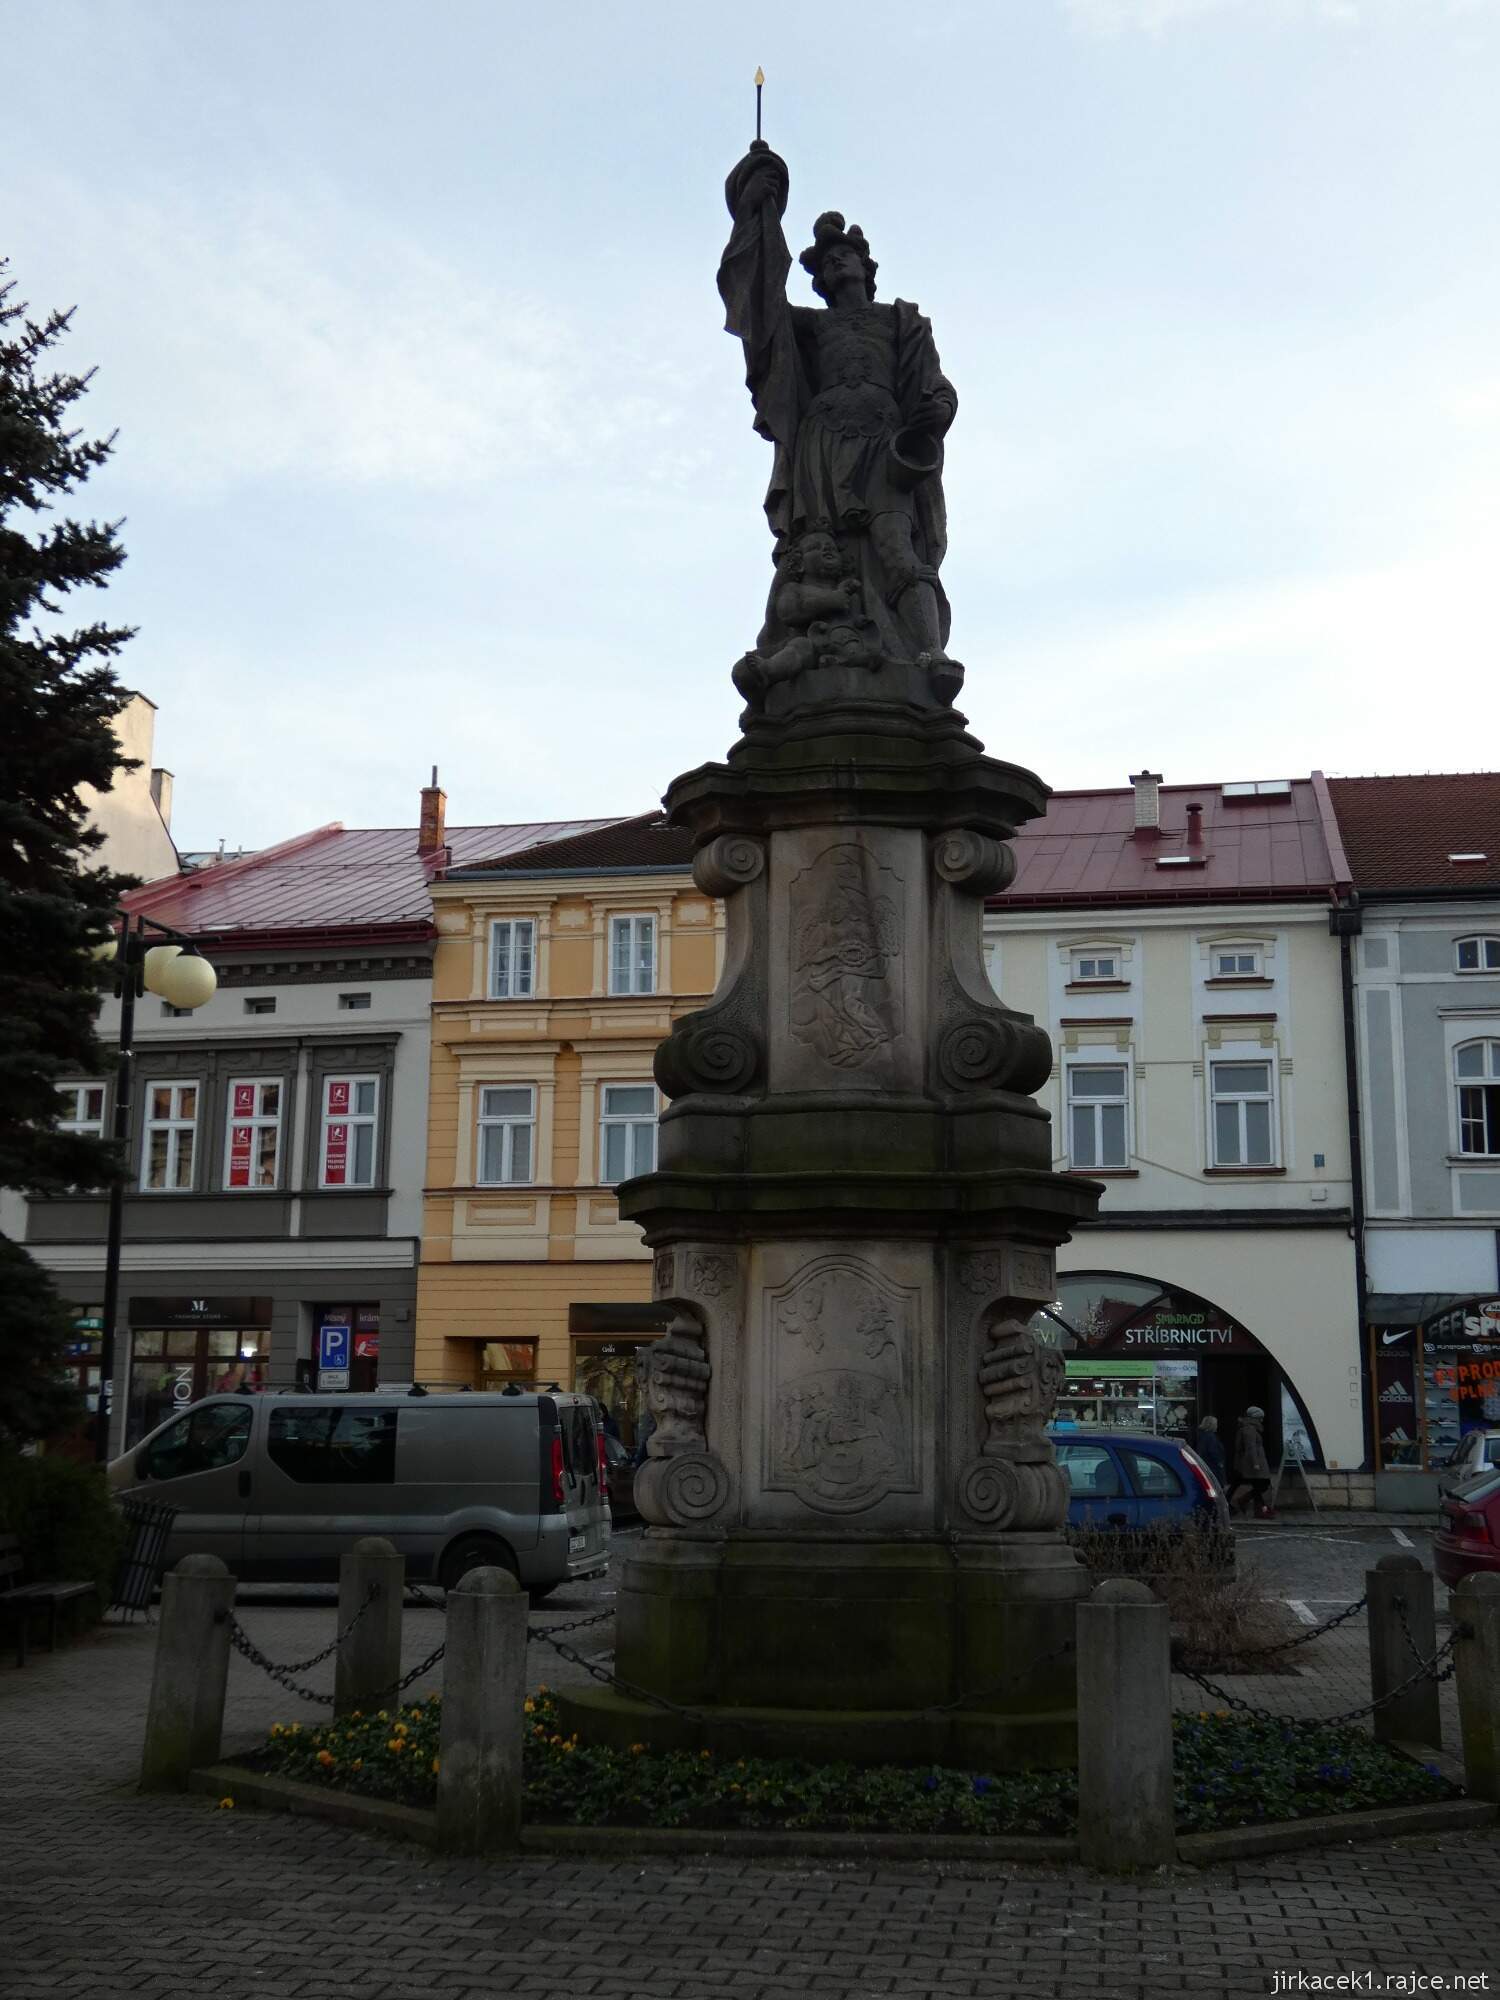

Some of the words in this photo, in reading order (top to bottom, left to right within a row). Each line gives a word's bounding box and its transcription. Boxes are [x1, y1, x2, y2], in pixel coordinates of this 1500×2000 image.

[1155, 1313, 1206, 1325] SMARAGD
[1125, 1325, 1234, 1344] STŘÍBRNICTVÍ
[326, 1331, 343, 1357] P
[1378, 1394, 1413, 1402] adidas
